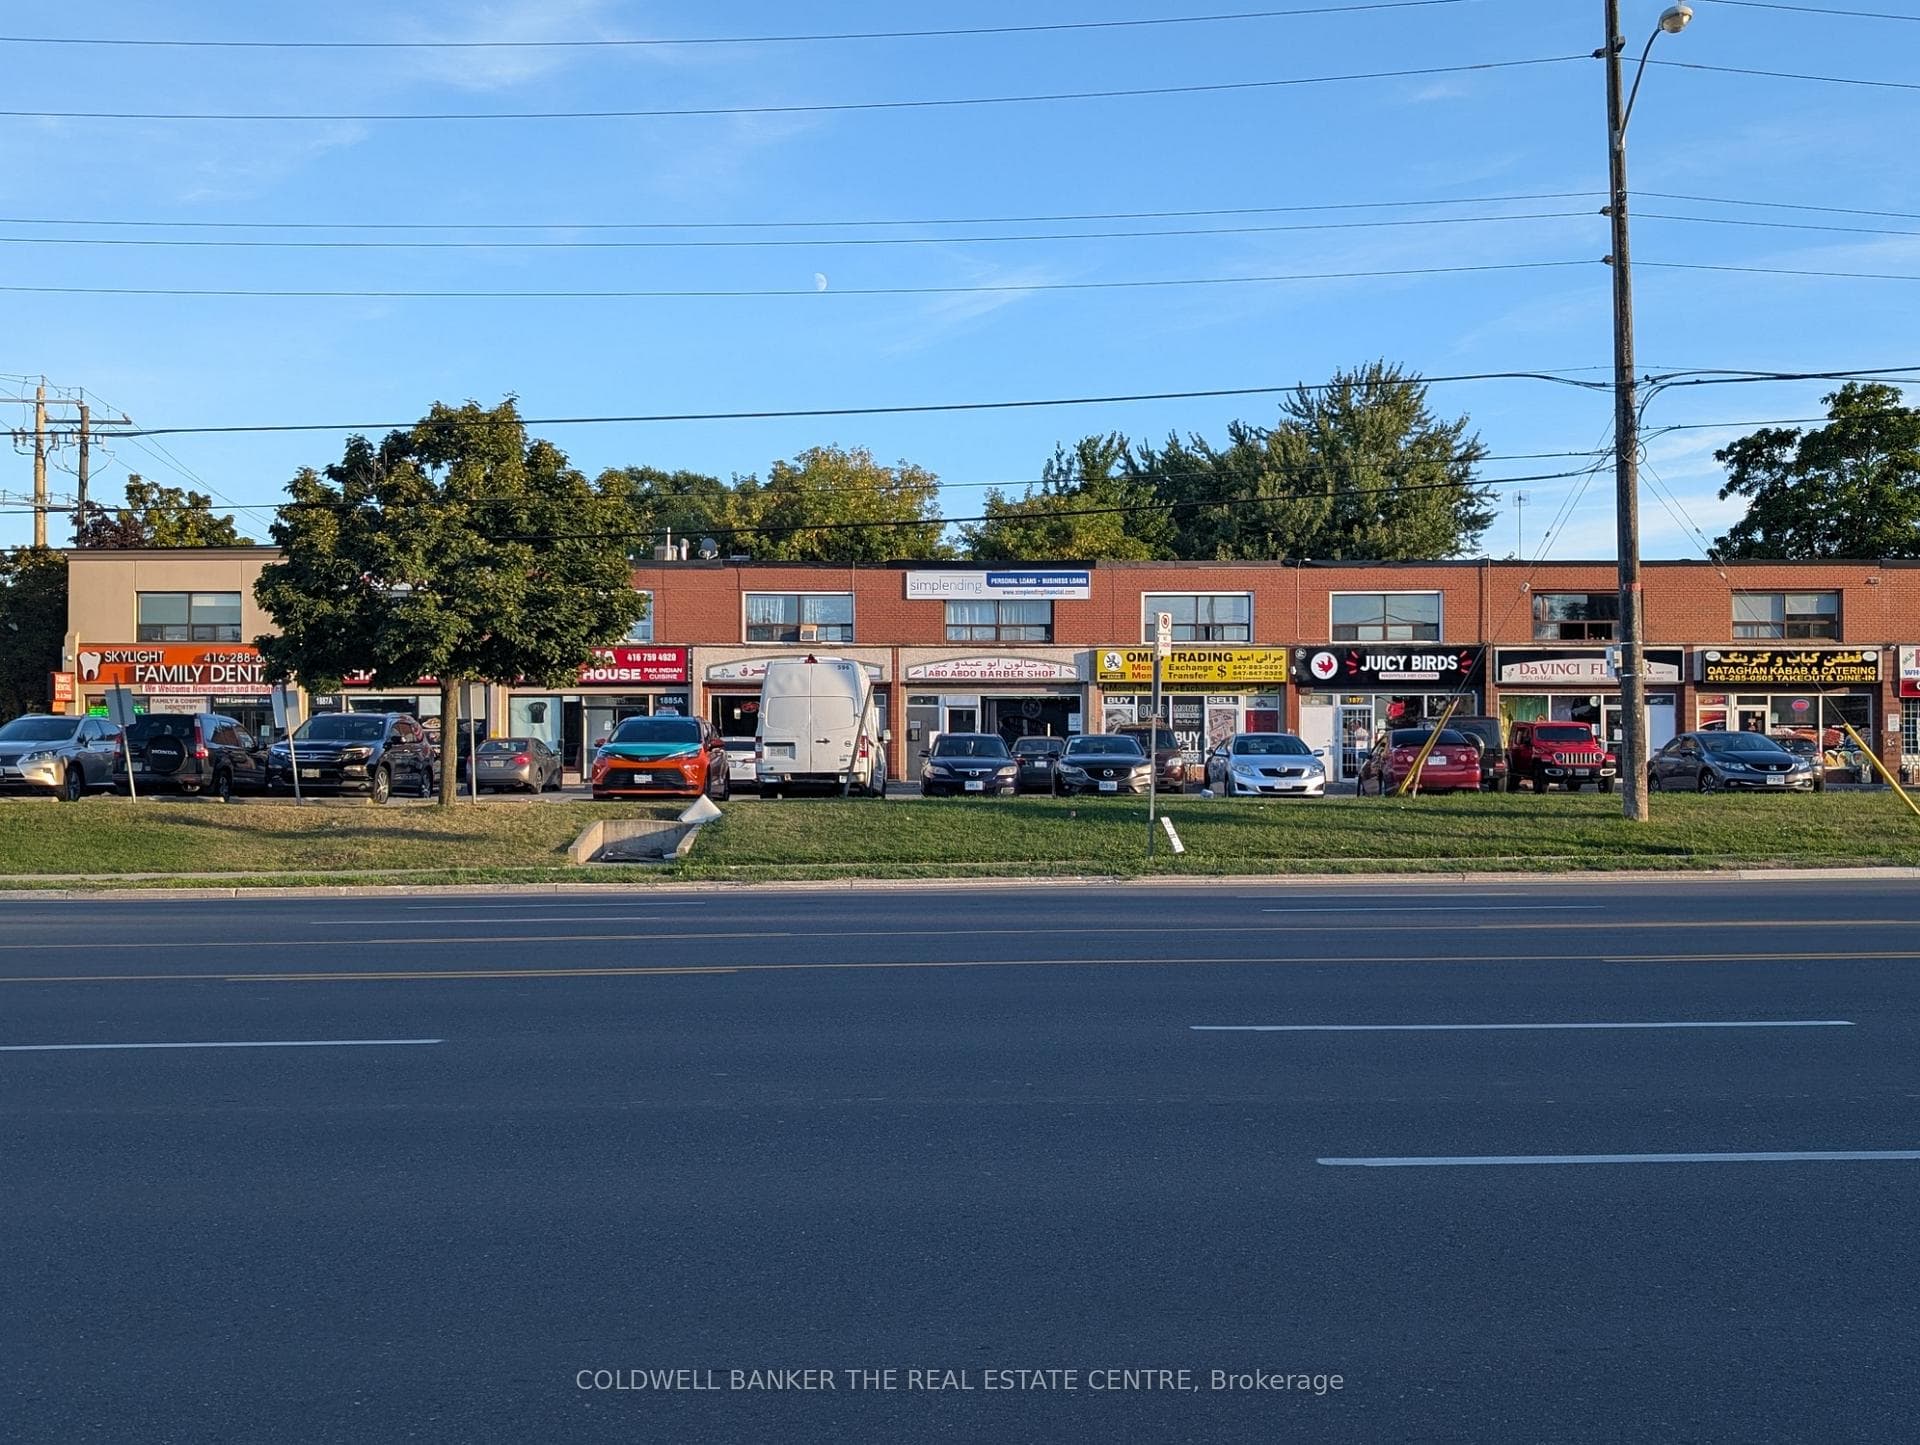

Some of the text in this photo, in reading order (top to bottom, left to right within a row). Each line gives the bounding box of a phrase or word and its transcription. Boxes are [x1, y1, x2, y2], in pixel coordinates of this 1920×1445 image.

[910, 578, 982, 593] simplending
[105, 651, 164, 662] SKYLIGHT
[627, 653, 641, 661] 416
[1171, 652, 1233, 663] TRADING
[1168, 664, 1214, 672] Exchange
[1360, 655, 1459, 671] JUICY BIRDS
[136, 665, 204, 682] FAMILY
[583, 668, 641, 680] HOUSE
[928, 670, 1056, 678] ABO ABDO BARBER SHOP
[1707, 666, 1876, 675] QATAGHAN KABAB & CATERING
[160, 685, 191, 693] Welcome
[193, 685, 234, 693] Newcomers
[236, 685, 249, 693] and
[1174, 731, 1201, 743] BUY
